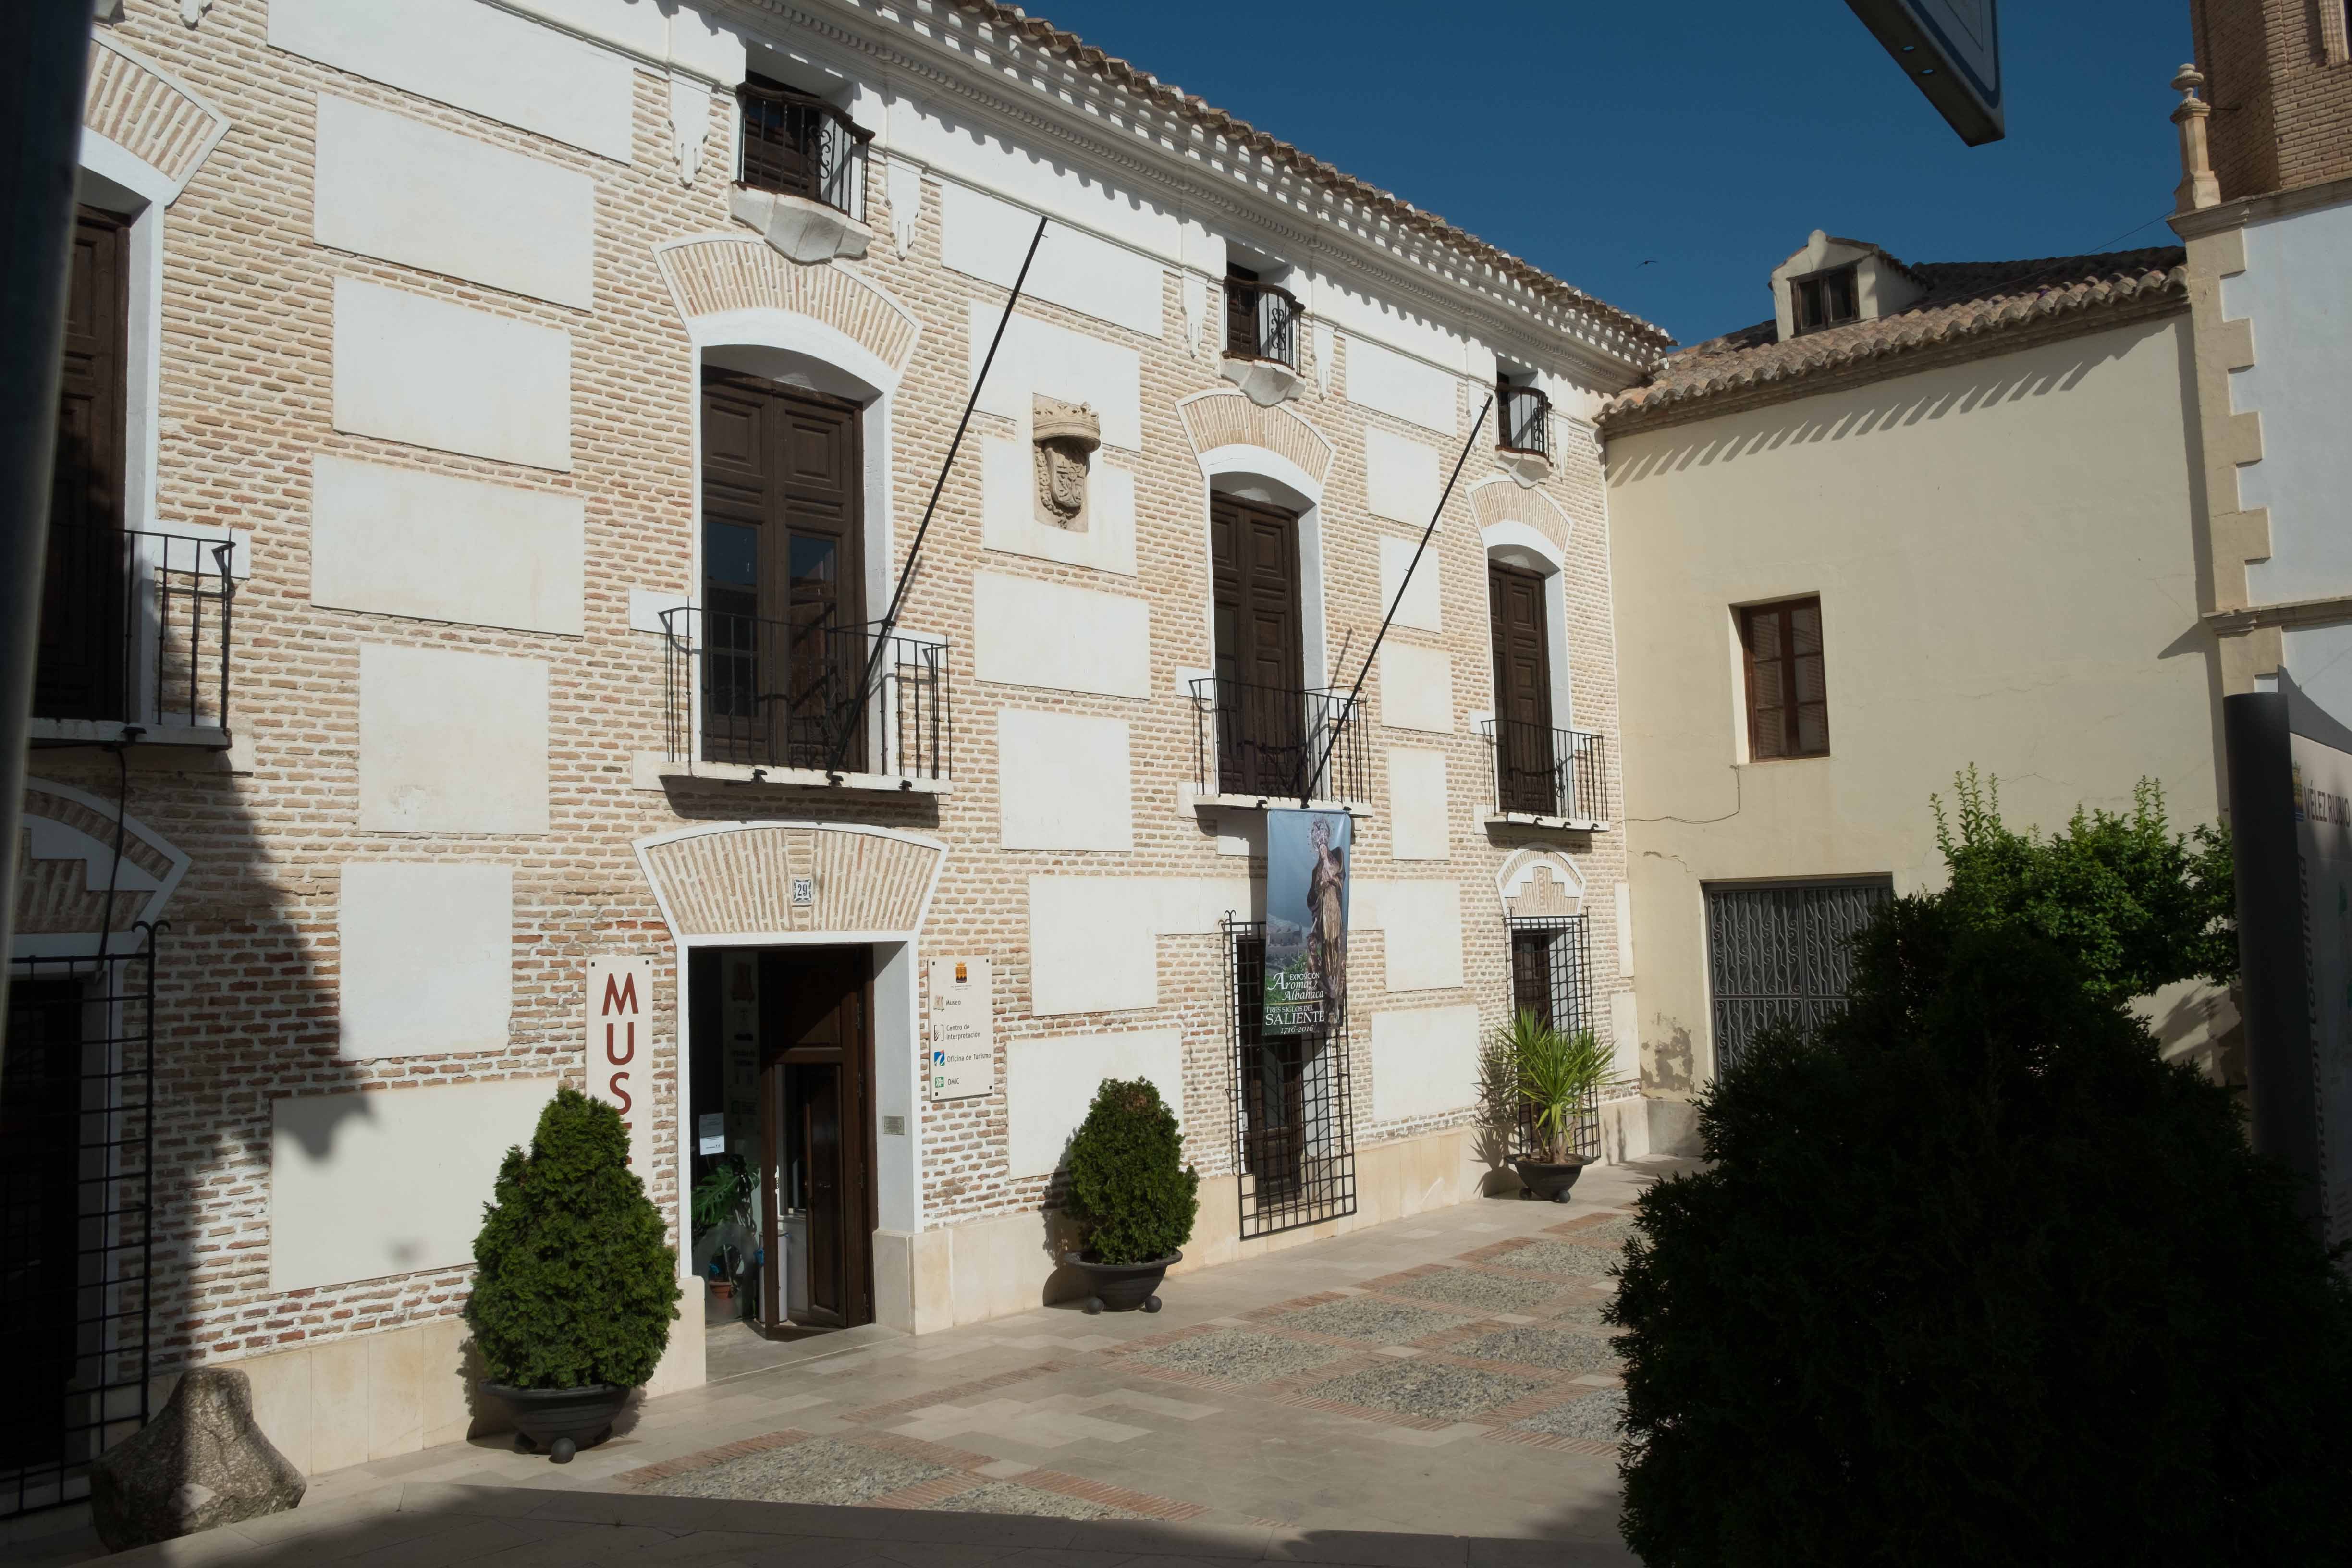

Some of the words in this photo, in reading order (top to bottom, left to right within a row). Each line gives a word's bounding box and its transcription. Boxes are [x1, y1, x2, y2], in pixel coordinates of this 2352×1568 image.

[2304, 780, 2327, 822] VÉLEZ
[2328, 793, 2350, 828] RUBIO
[797, 884, 807, 896] 29
[1267, 972, 1312, 990] Aromas
[1290, 972, 1320, 980] EXPOSICIÓN
[1282, 989, 1324, 1001] Albahaca
[1265, 1010, 1324, 1026] SALIENTE
[946, 1031, 980, 1041] Interpretación
[1280, 1025, 1314, 1035] 1716-2016
